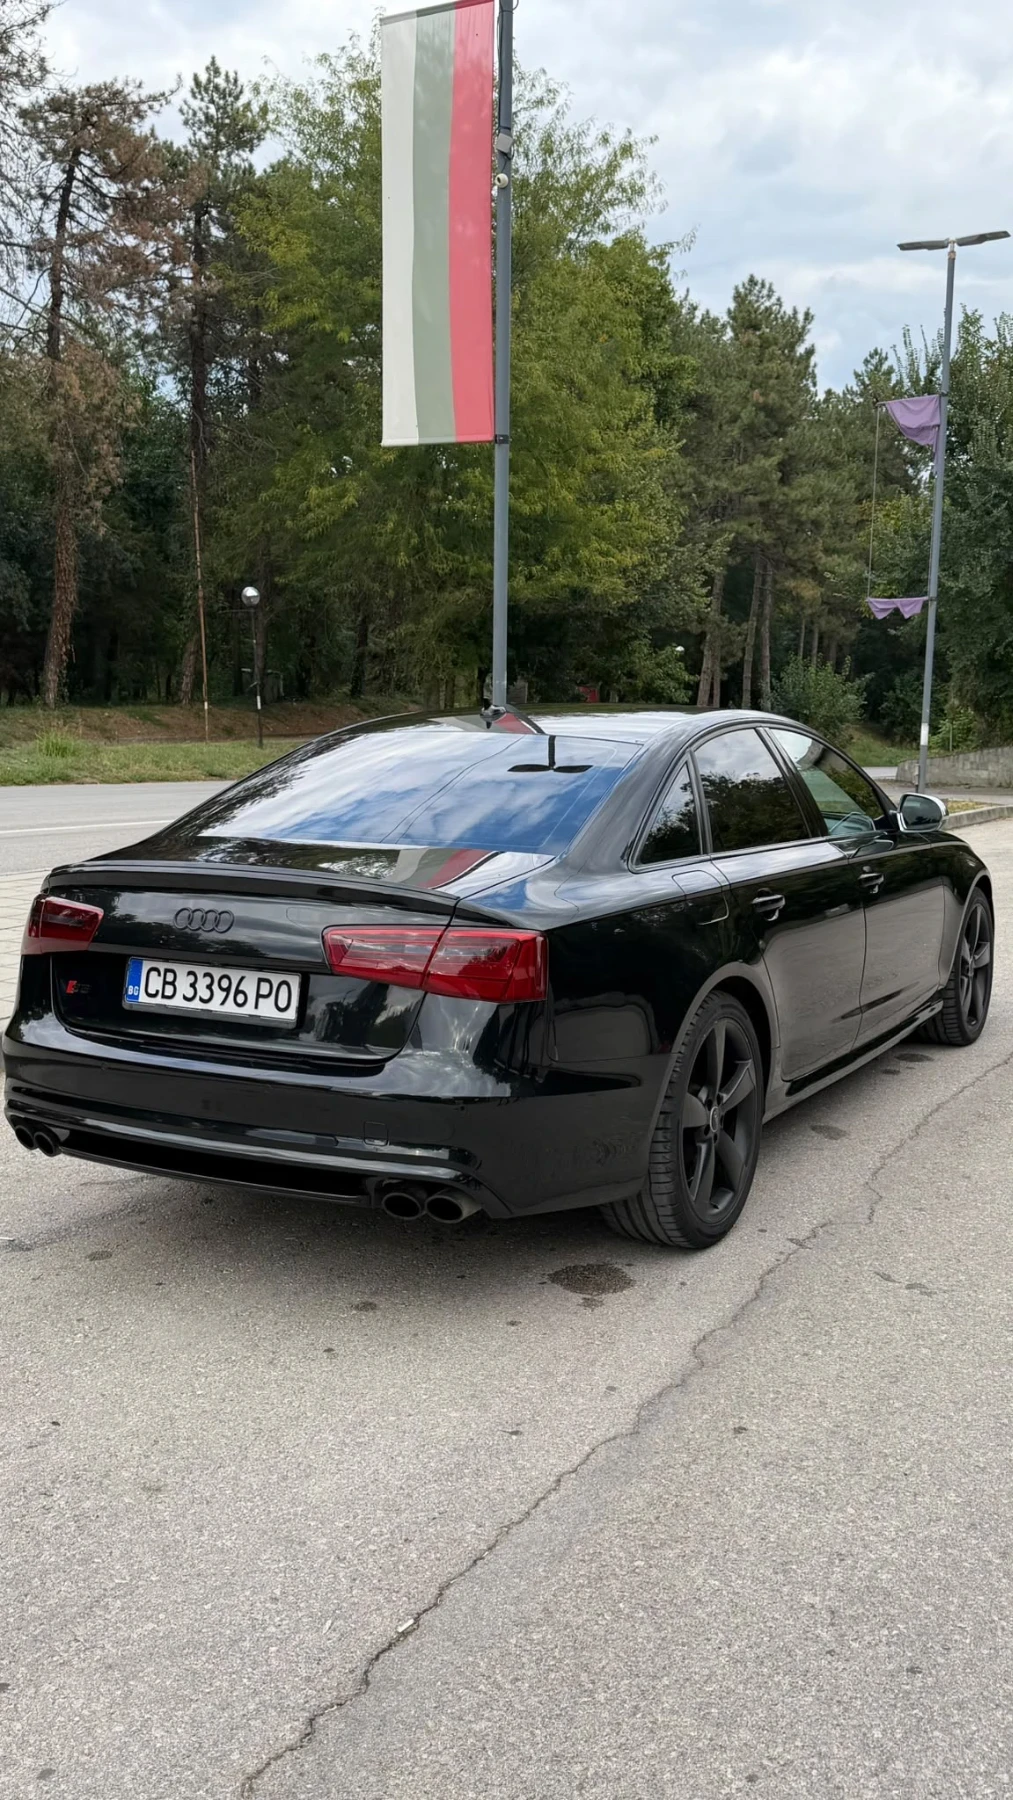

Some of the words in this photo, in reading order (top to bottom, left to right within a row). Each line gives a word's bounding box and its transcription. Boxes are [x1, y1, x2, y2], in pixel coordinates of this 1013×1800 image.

[128, 985, 139, 995] BG
[144, 966, 177, 999] CB
[182, 970, 248, 1008] 3396
